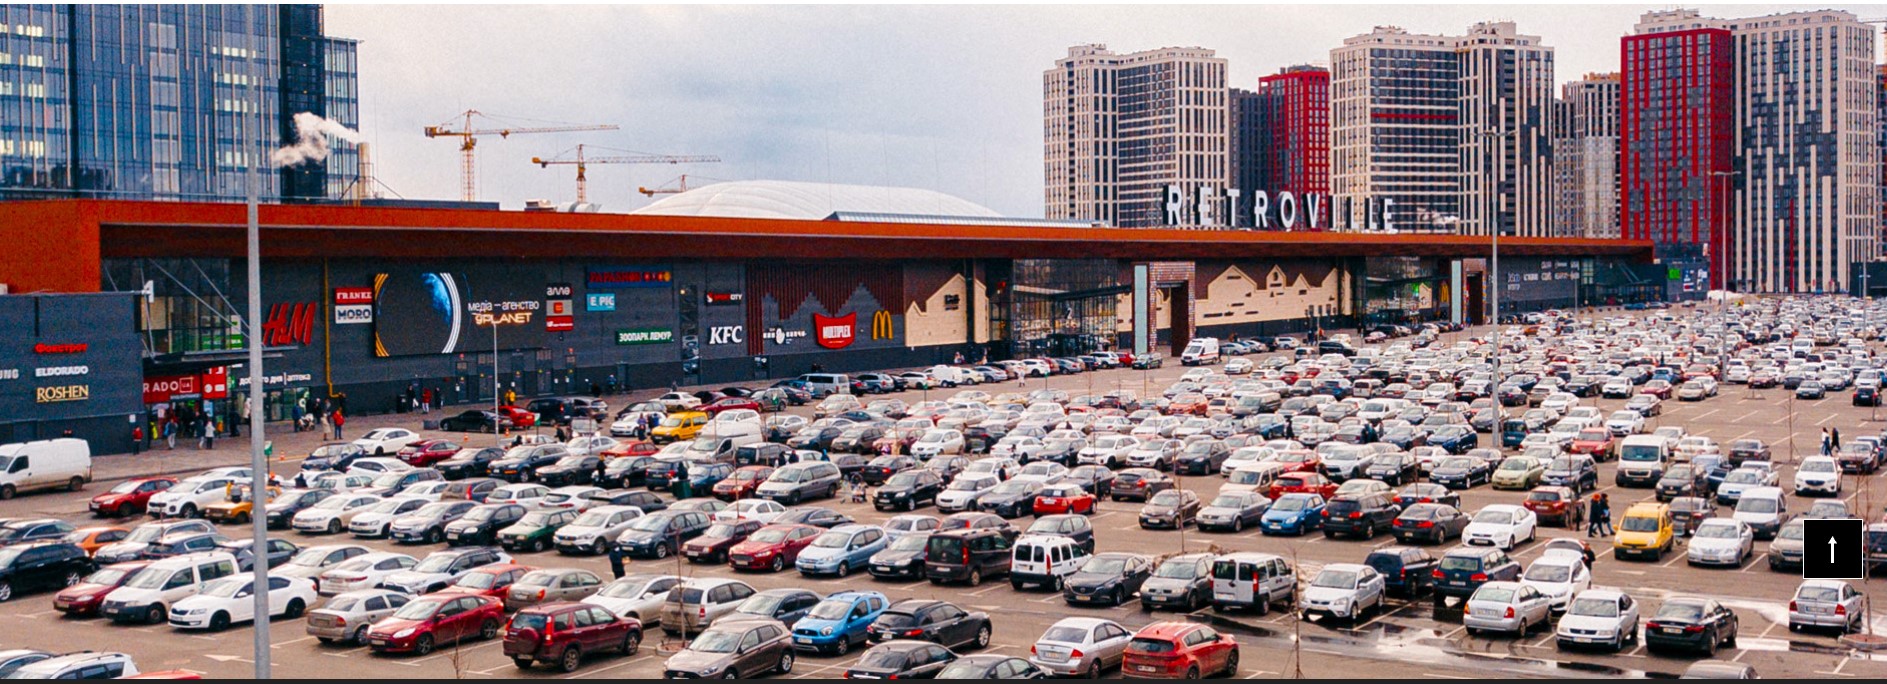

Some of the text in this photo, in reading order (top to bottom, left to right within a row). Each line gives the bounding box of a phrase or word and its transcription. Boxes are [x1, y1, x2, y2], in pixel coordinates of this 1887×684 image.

[1164, 185, 1397, 234] RETROVILLE
[336, 291, 372, 300] FRANKE
[338, 308, 371, 320] MORO
[262, 302, 316, 346] H&M
[709, 325, 743, 344] KFC
[35, 366, 89, 377] ELDORADO
[36, 385, 89, 402] ROSHEN
